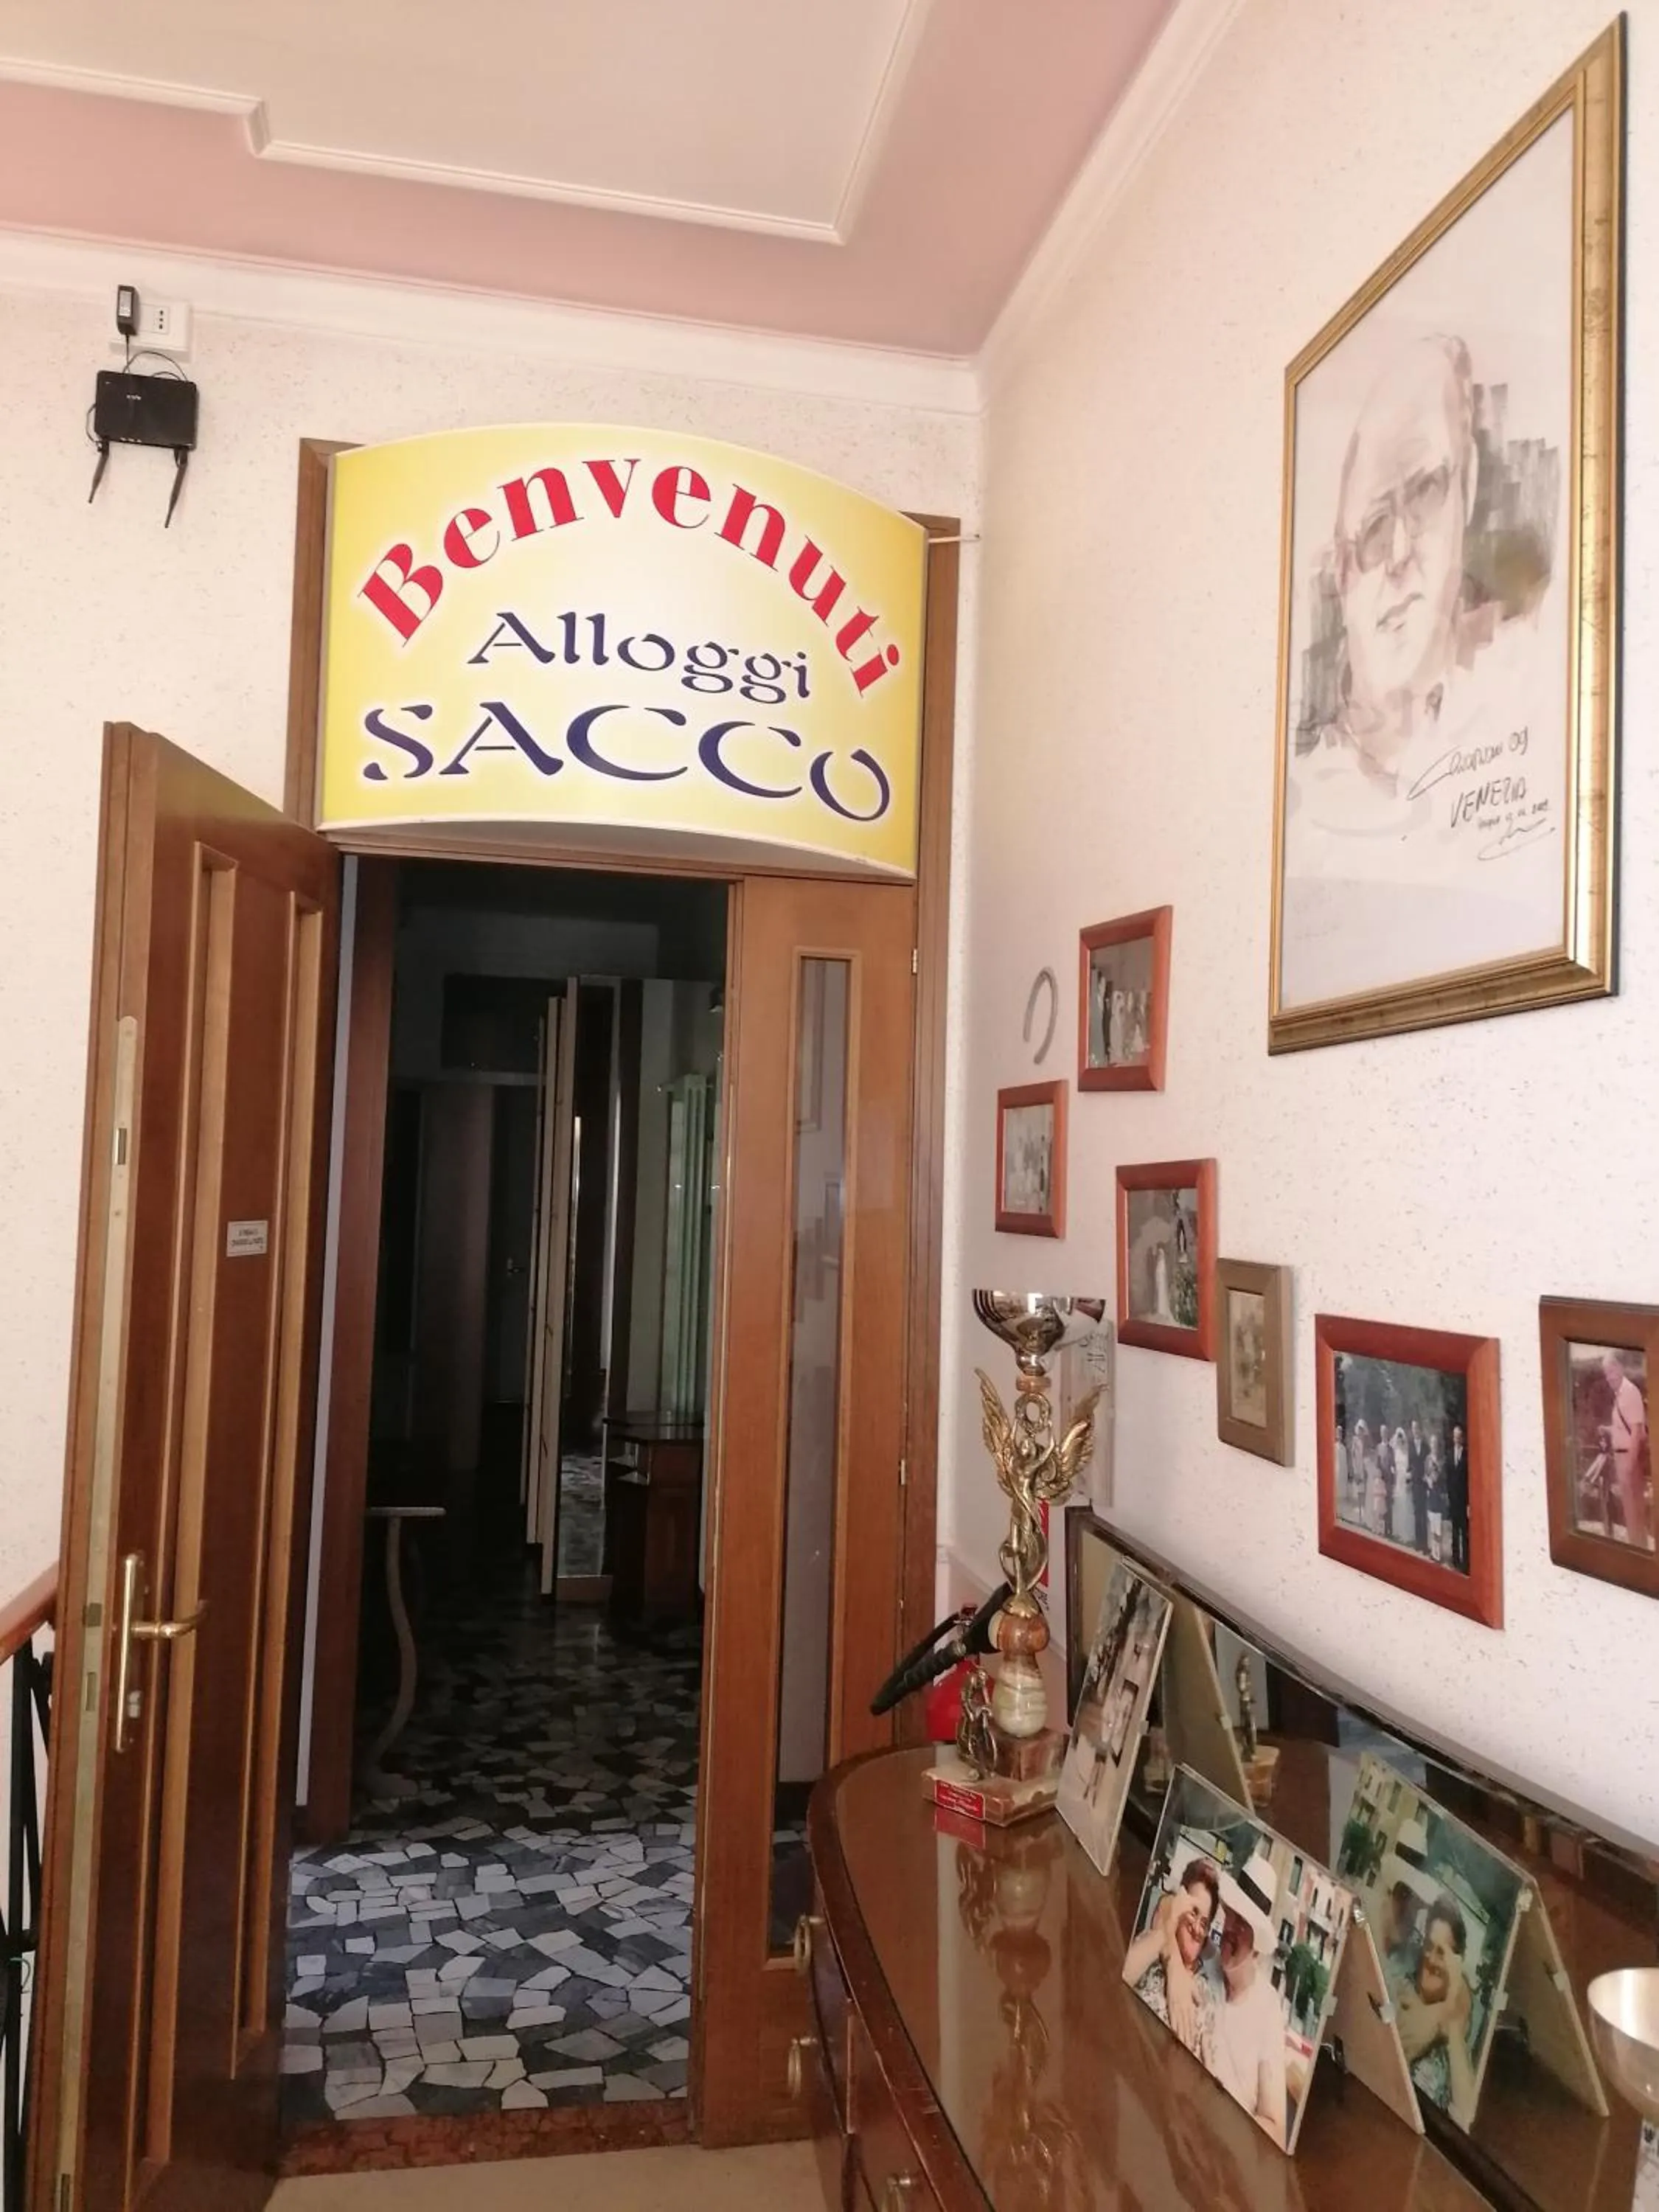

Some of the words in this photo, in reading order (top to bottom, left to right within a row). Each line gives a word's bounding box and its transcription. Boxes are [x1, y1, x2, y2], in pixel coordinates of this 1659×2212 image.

[358, 458, 900, 698] Benvenuti
[467, 611, 810, 703] Alloggi
[364, 701, 891, 821] SACCO
[1450, 776, 1527, 827] VENEZIA
